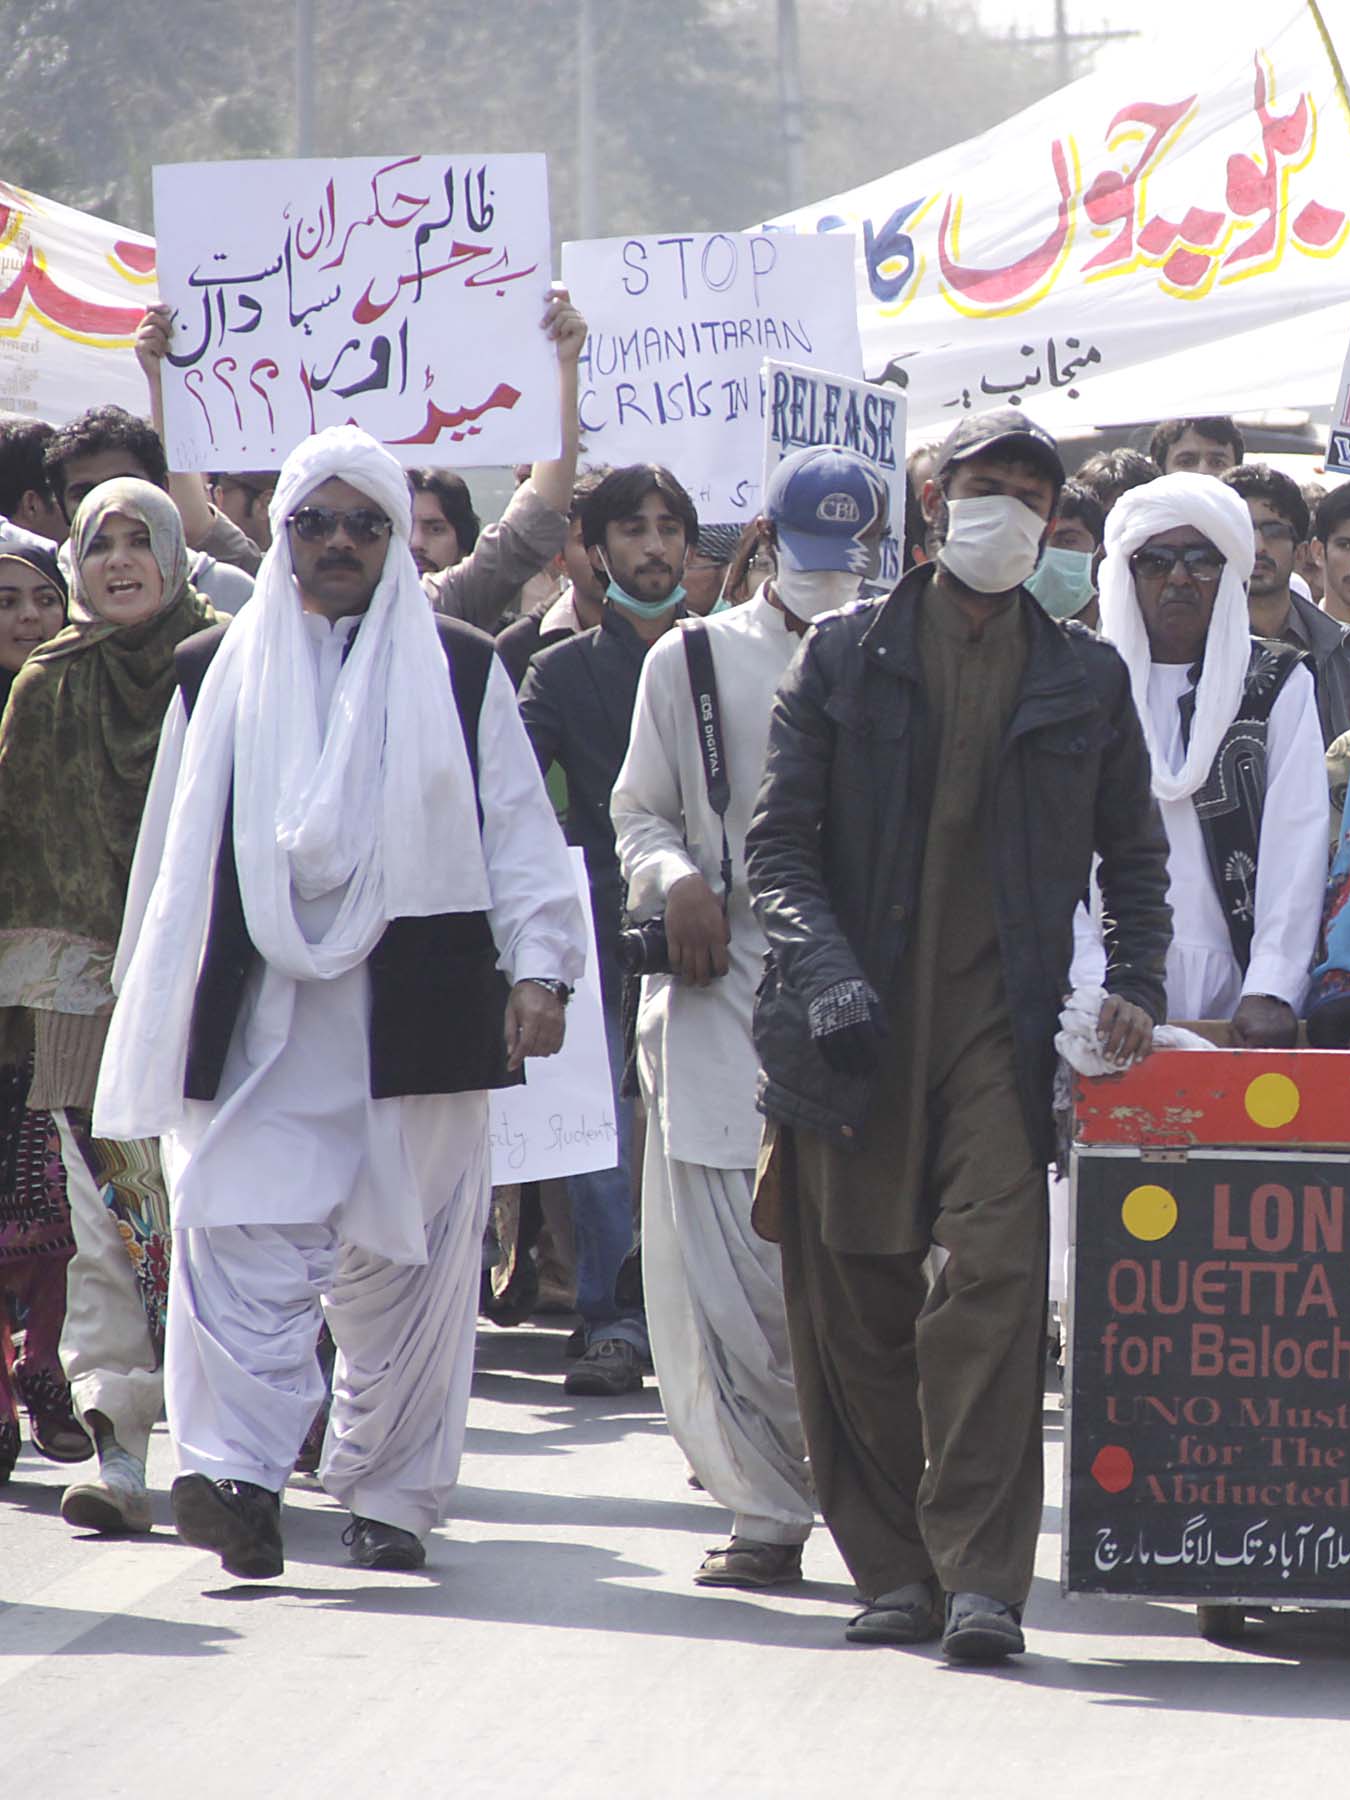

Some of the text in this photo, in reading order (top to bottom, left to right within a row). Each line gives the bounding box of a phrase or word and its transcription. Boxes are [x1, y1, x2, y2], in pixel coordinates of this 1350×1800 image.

[295, 155, 431, 273] حکمران
[412, 163, 496, 303] ظالم
[621, 233, 778, 308] STOP
[310, 315, 409, 399] اور
[577, 318, 813, 383] HUMANITARIAN
[579, 373, 713, 432] CRISIS
[720, 380, 749, 422] IN
[771, 371, 897, 470] RELEASE
[700, 693, 720, 777] EOS DIGITAL
[1106, 1258, 1339, 1318] QUETTA
[1101, 1322, 1173, 1376] for
[1105, 1395, 1223, 1427] UNO
[1238, 1397, 1350, 1430] Must
[1175, 1434, 1243, 1466] for
[1260, 1436, 1346, 1469] The
[1136, 1474, 1350, 1507] Abducted
[1093, 1527, 1151, 1572] مارچ
[1153, 1513, 1213, 1566] لانگ
[1214, 1519, 1269, 1566] تک
[1262, 1522, 1315, 1579] آباد
